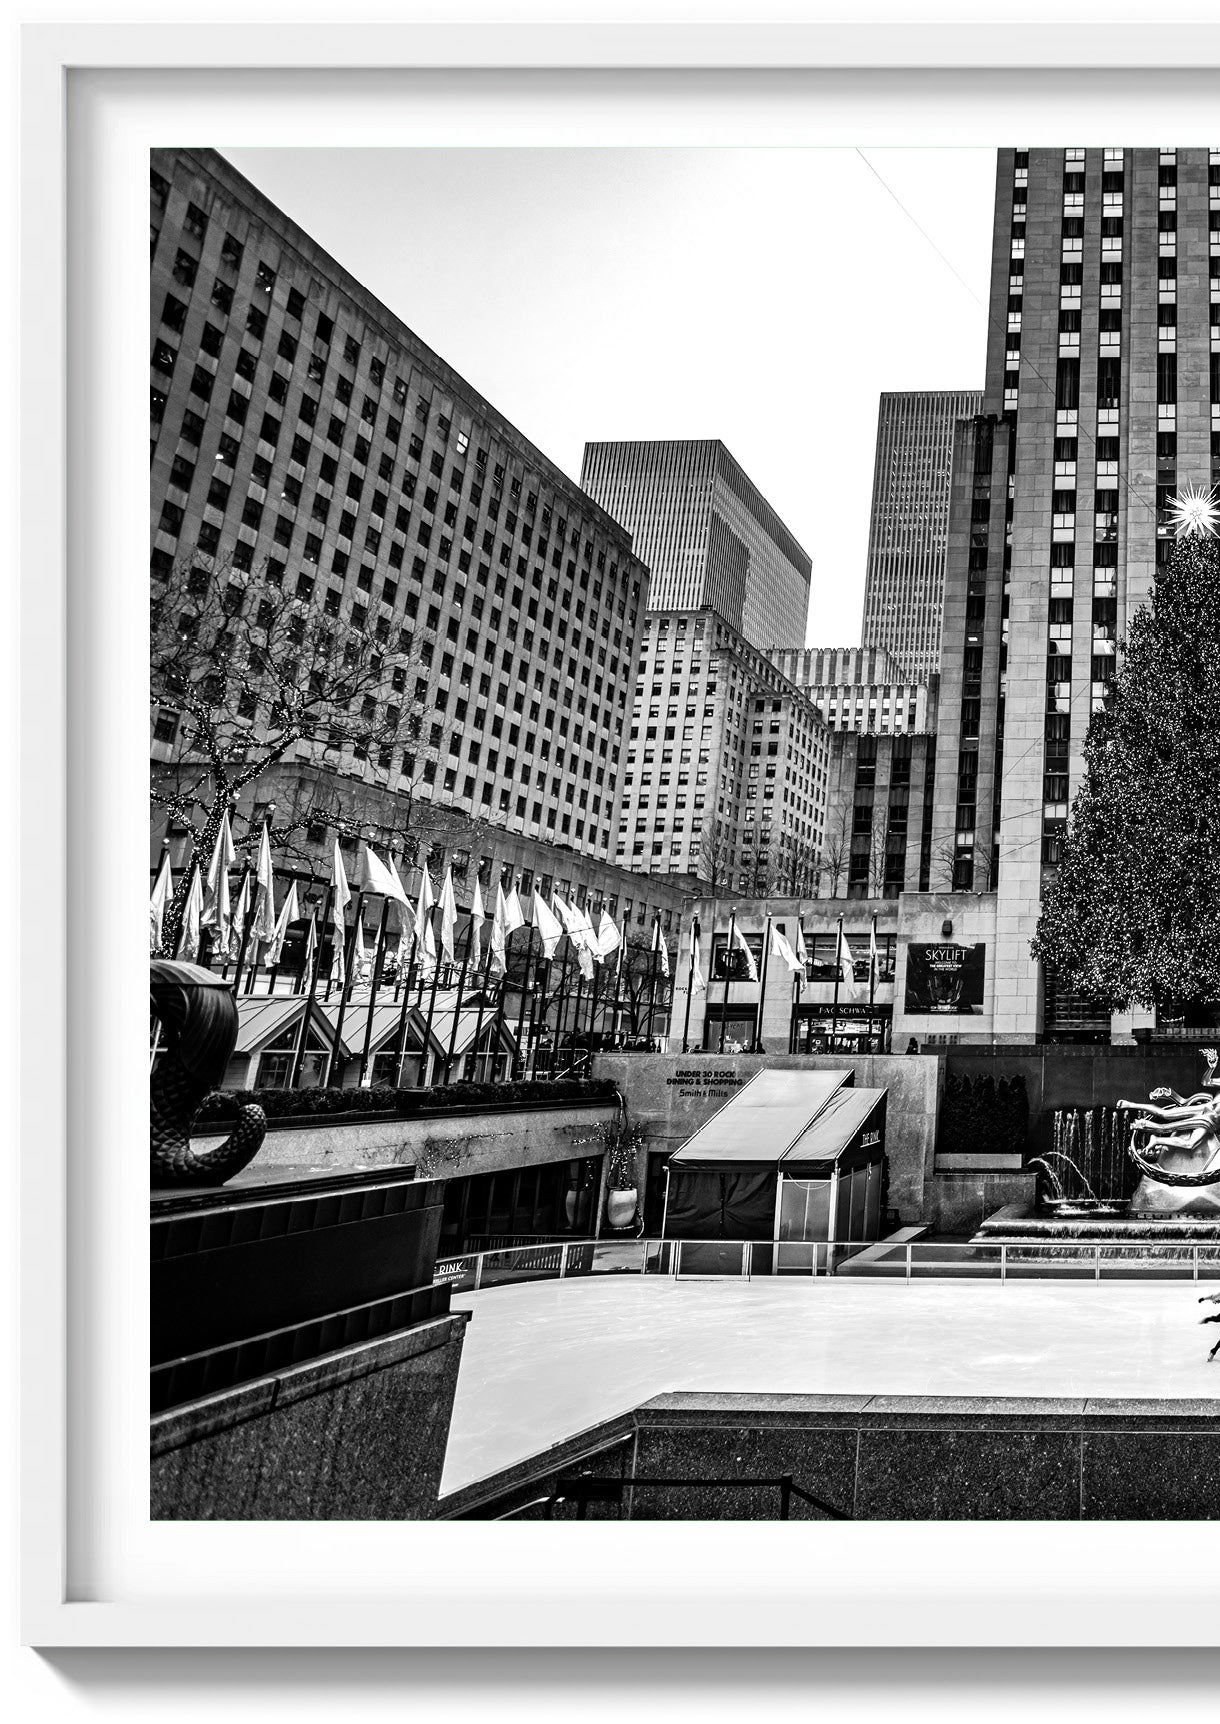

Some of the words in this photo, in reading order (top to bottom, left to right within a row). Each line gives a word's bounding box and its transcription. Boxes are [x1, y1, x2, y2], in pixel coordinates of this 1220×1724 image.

[925, 949, 967, 961] SKYLIFT
[679, 1089, 701, 1097] Smith
[440, 1262, 463, 1274] RINK
